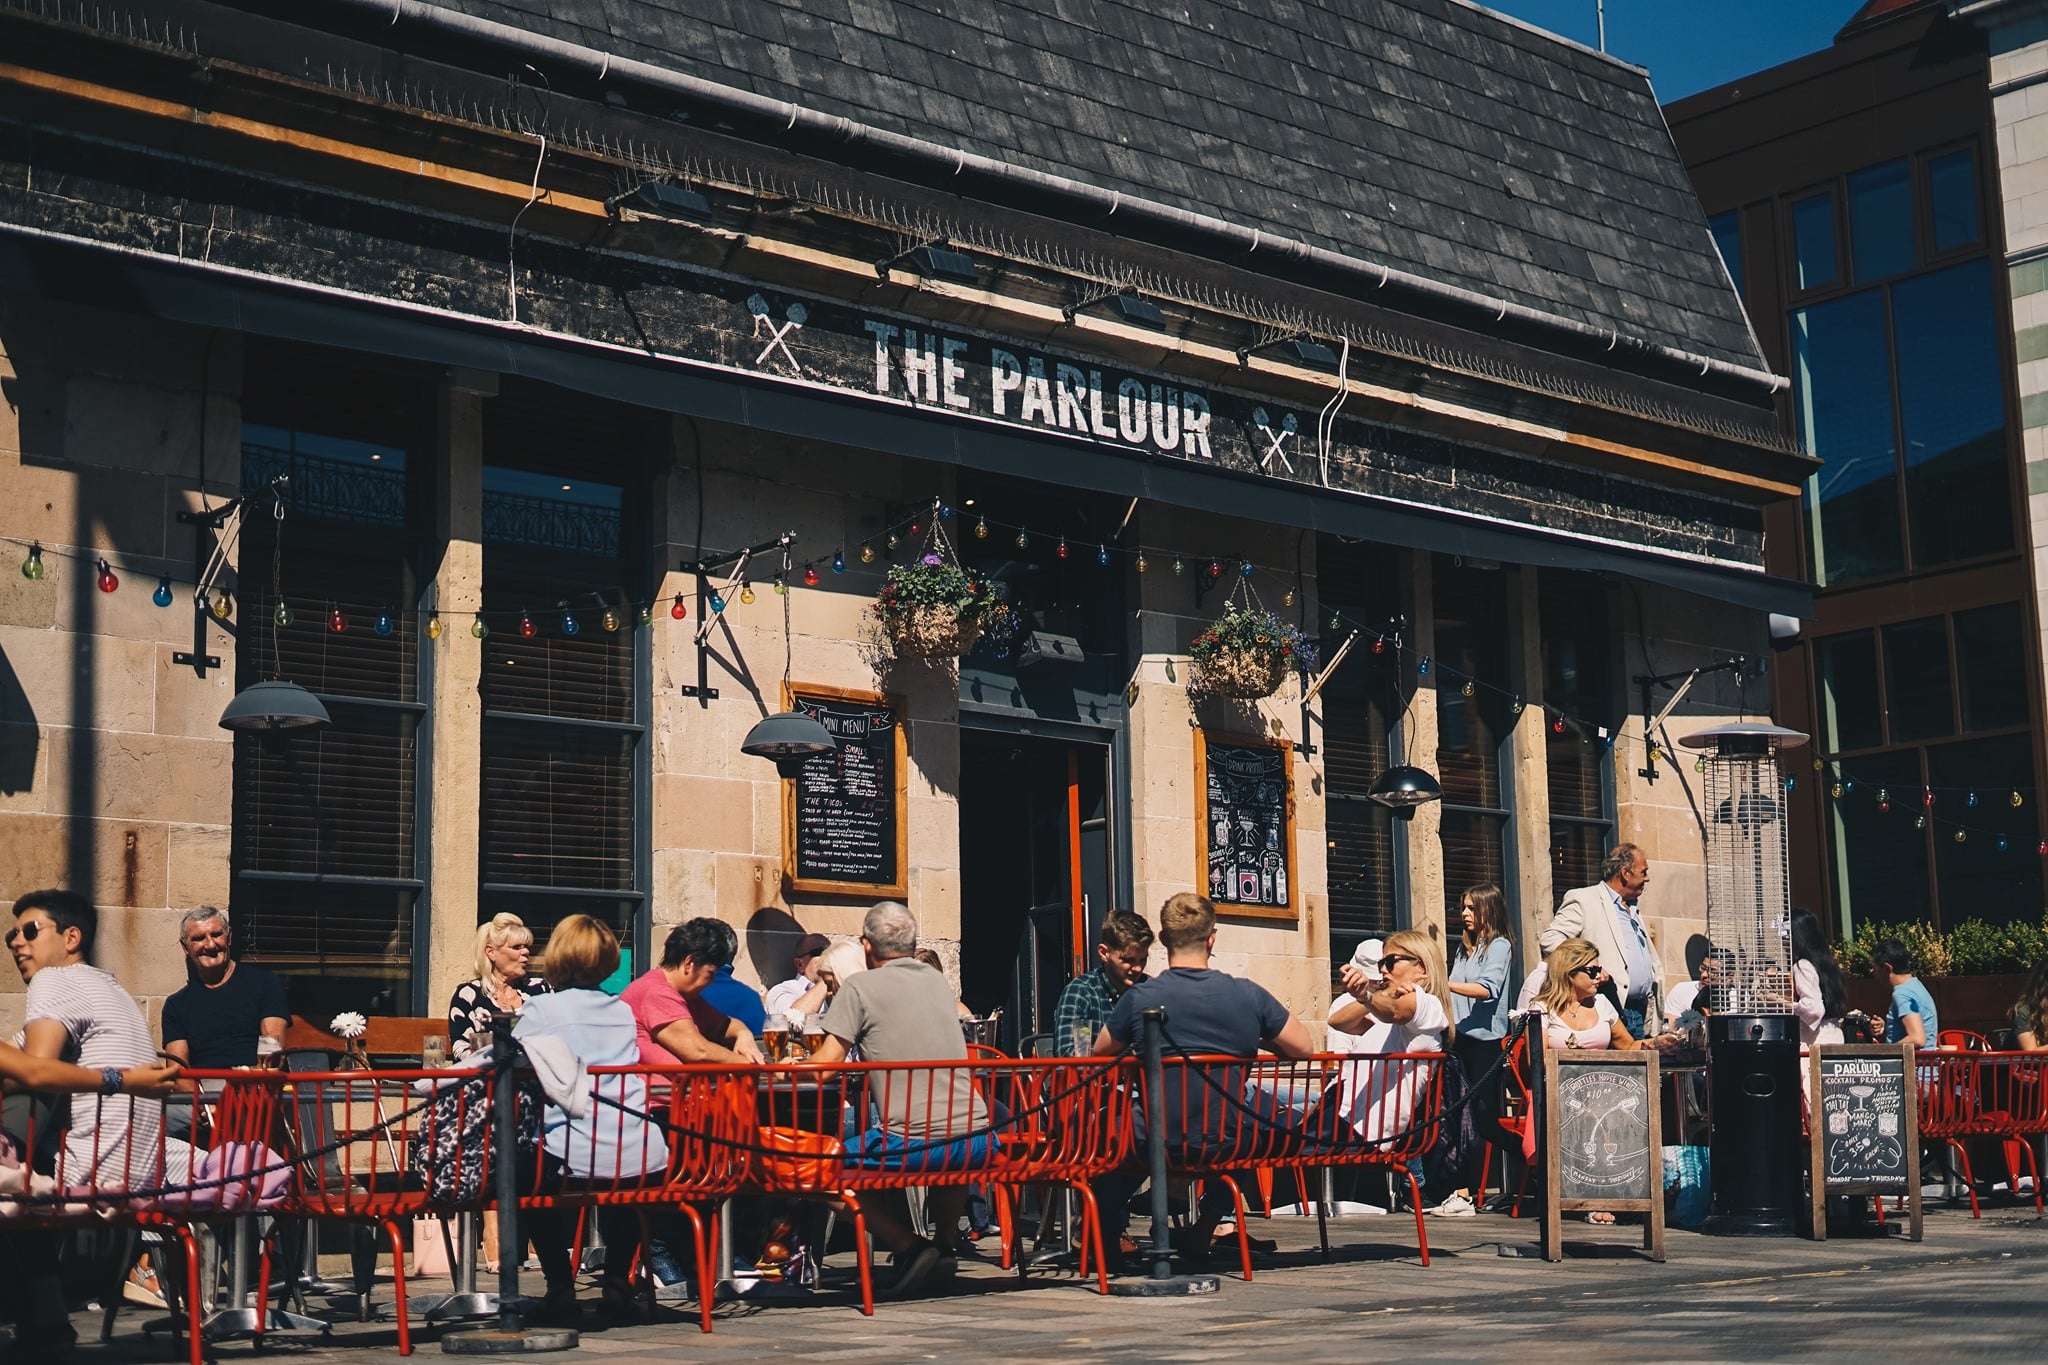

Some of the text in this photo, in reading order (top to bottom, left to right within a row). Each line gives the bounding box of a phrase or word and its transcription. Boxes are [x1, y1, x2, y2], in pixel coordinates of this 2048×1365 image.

[864, 319, 1212, 458] THE PARLOUR
[823, 717, 865, 734] MINI MENU
[805, 797, 820, 805] THE
[1834, 1063, 1881, 1077] PARLOUR
[1570, 1075, 1596, 1091] BOTTLES
[1598, 1074, 1617, 1084] HOUSE
